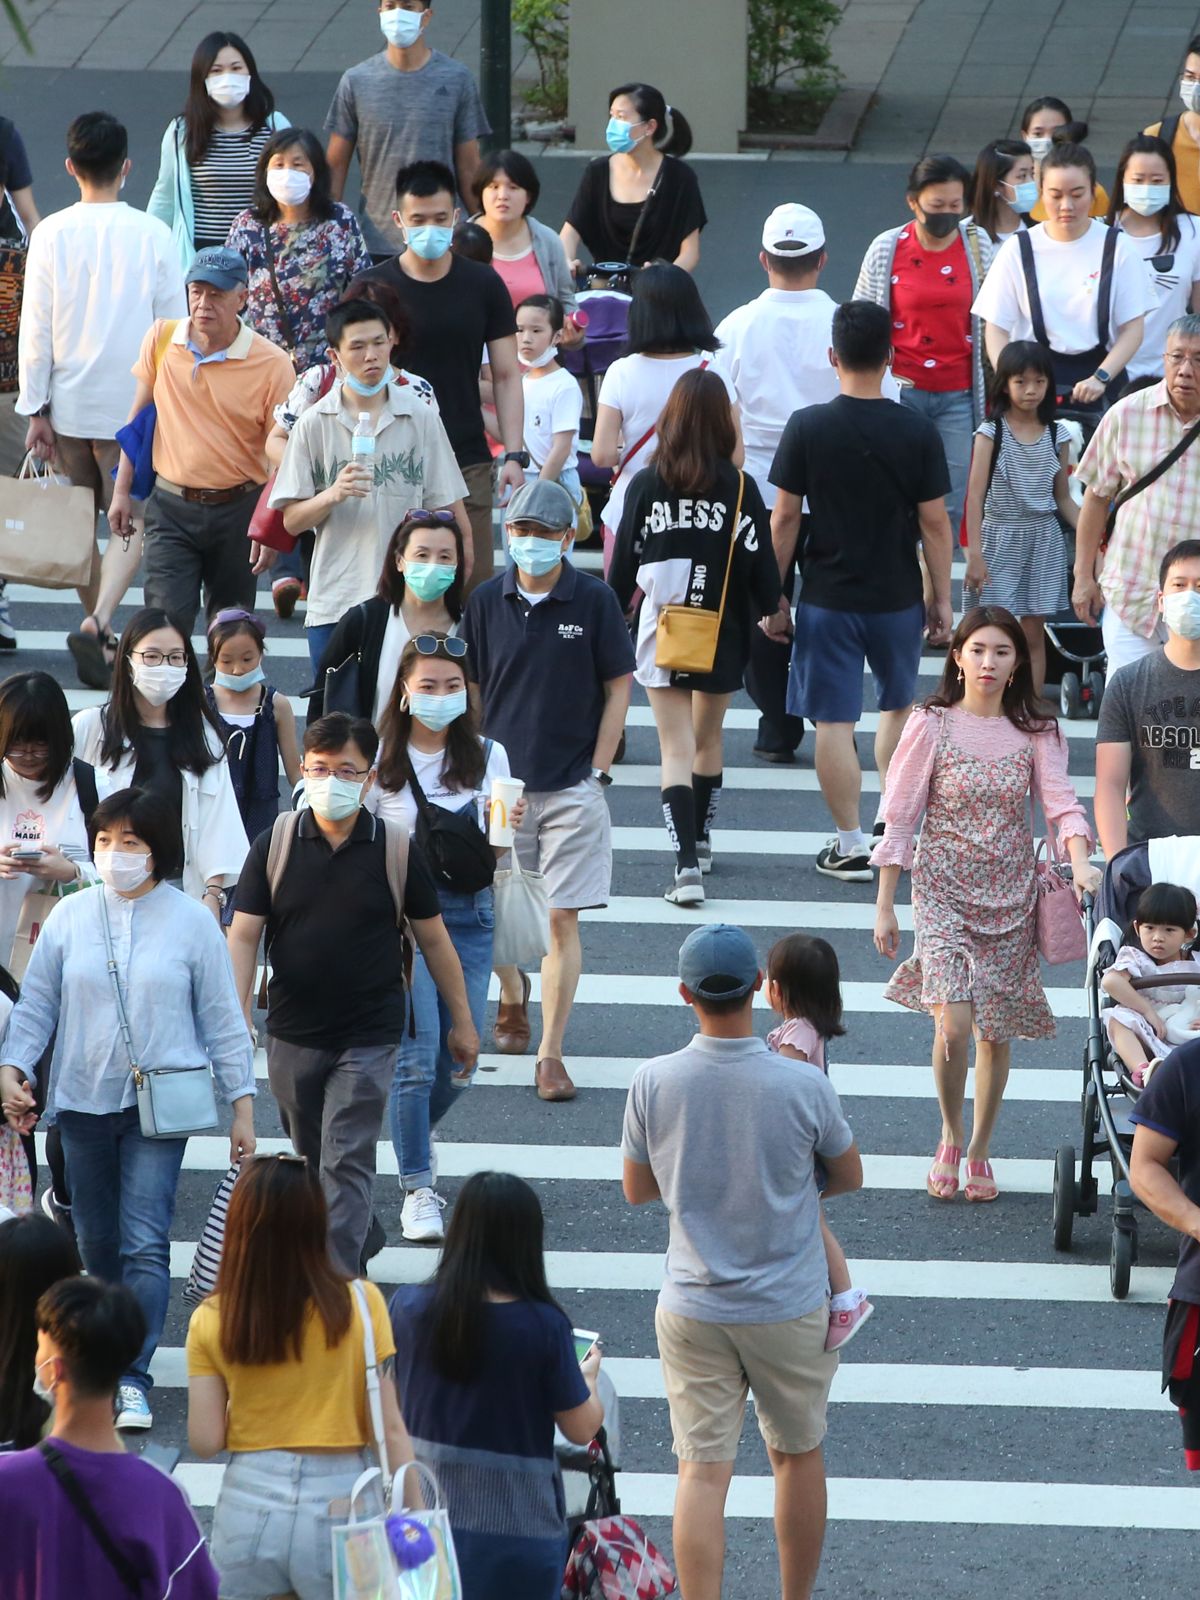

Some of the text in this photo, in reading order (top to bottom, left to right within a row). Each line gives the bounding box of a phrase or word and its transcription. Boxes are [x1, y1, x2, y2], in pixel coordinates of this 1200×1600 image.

[650, 499, 727, 534] BLESS
[691, 564, 707, 590] ONE
[14, 831, 42, 840] MARIE
